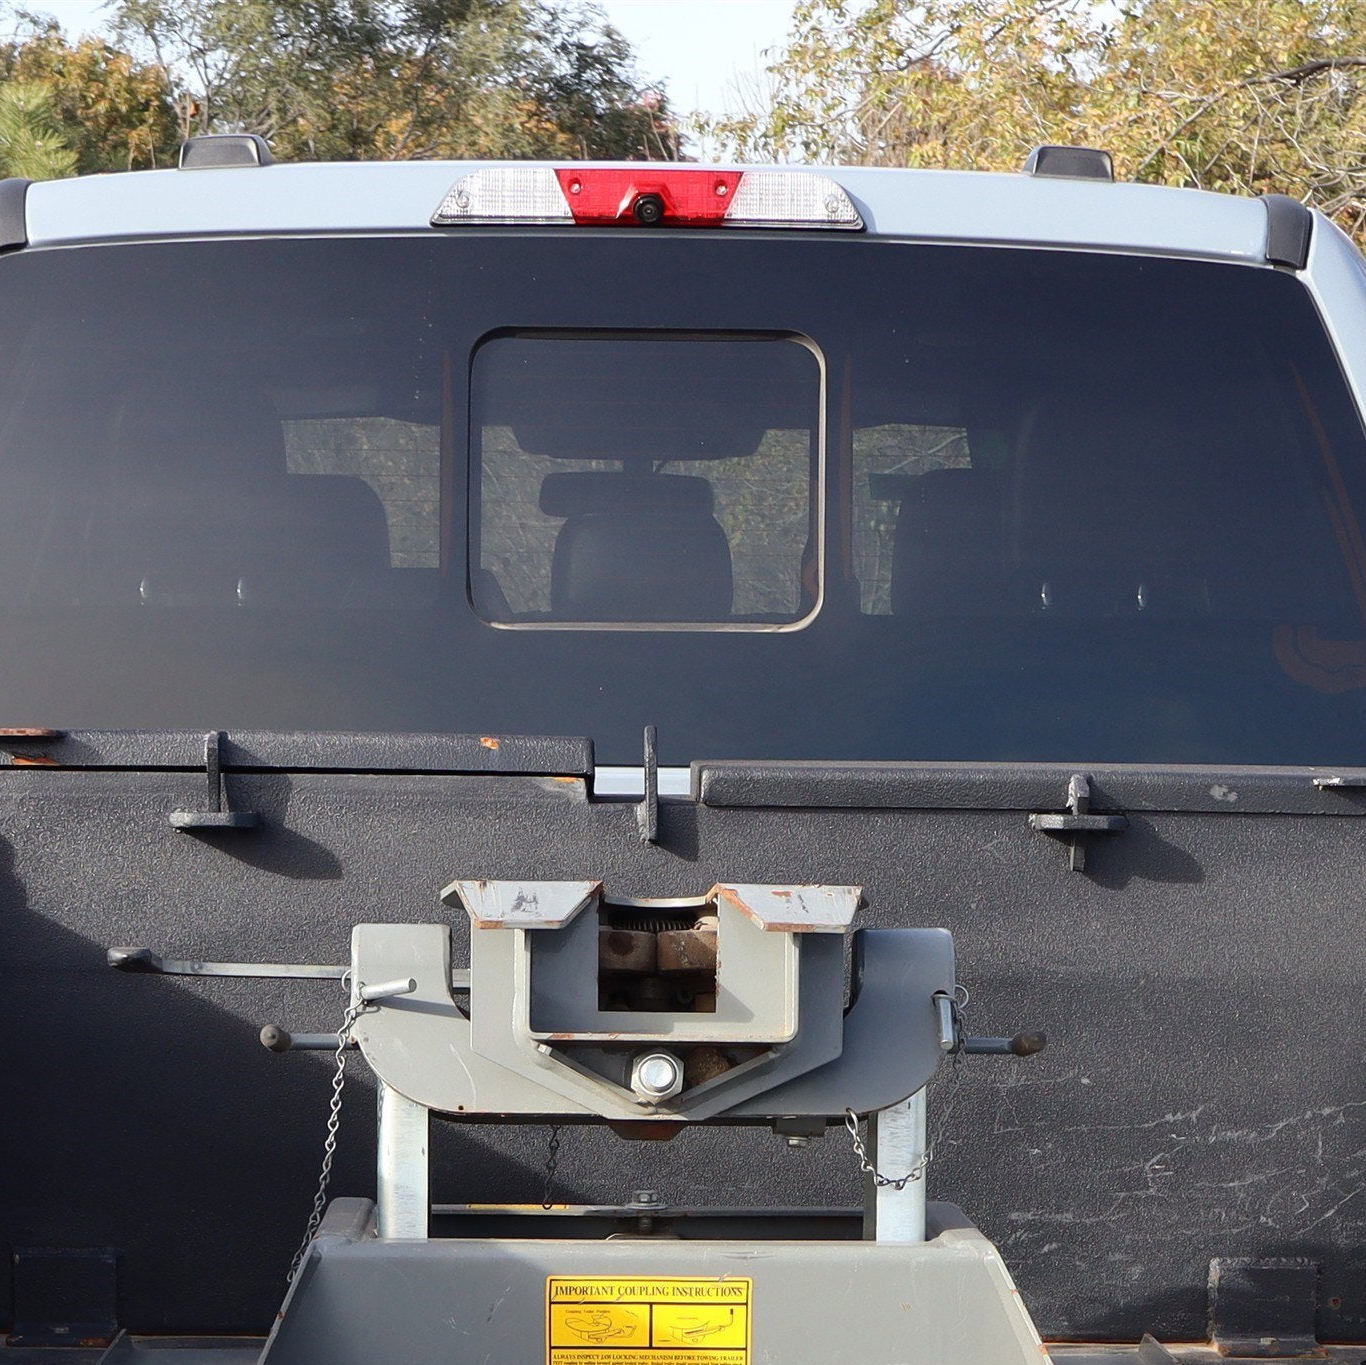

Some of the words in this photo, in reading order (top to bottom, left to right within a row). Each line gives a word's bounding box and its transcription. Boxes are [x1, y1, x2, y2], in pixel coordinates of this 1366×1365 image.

[555, 1286, 614, 1296] IMPORTANT
[618, 1286, 669, 1296] COUPLING
[672, 1287, 742, 1297] INSTRUCTIONS
